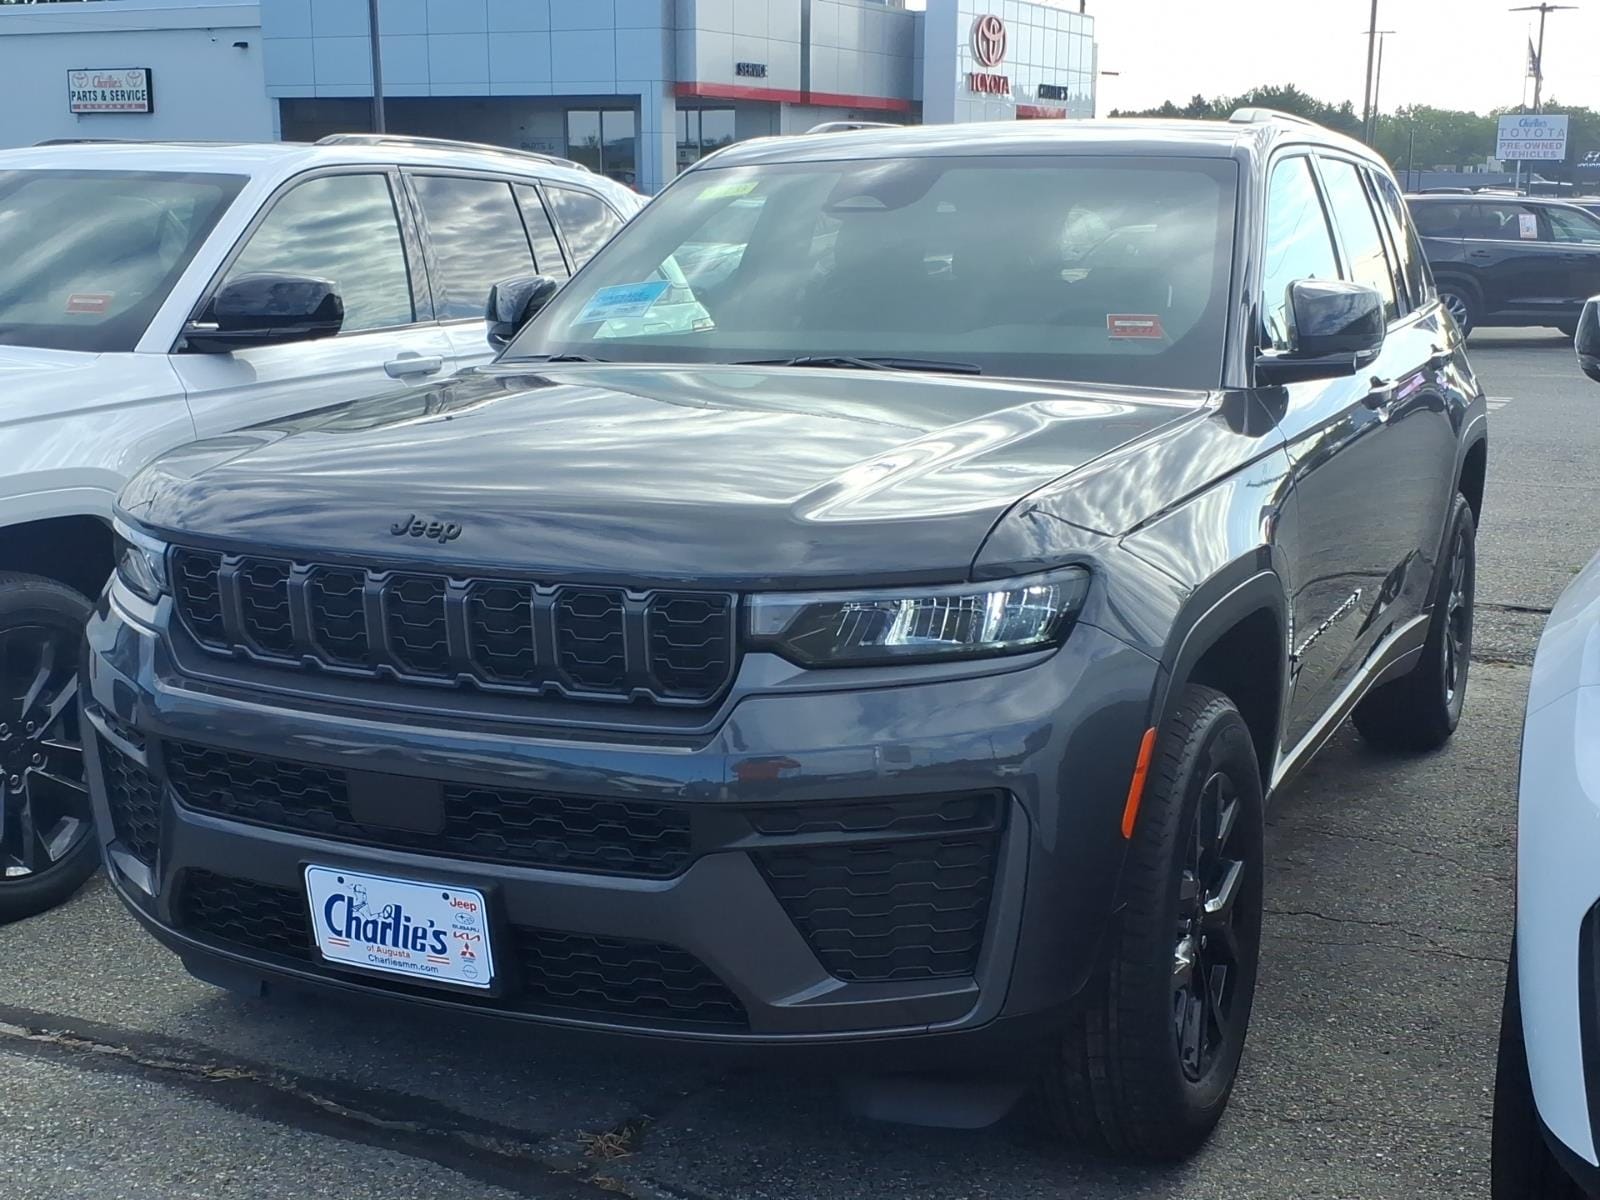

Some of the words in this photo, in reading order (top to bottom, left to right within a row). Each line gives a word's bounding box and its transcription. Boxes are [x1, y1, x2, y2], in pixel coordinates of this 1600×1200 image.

[968, 72, 1010, 95] TOYOTA
[71, 90, 98, 102] PARTS
[101, 90, 107, 102] &
[109, 89, 147, 102] SERVICE
[1499, 128, 1565, 138] TOYOTA
[1504, 150, 1557, 159] VEHICLES
[390, 513, 463, 544] Jeep
[450, 897, 477, 912] Jeep
[324, 893, 448, 955] Charlie's
[376, 945, 411, 958] Augusta
[368, 953, 439, 973] Charliesmm.com
